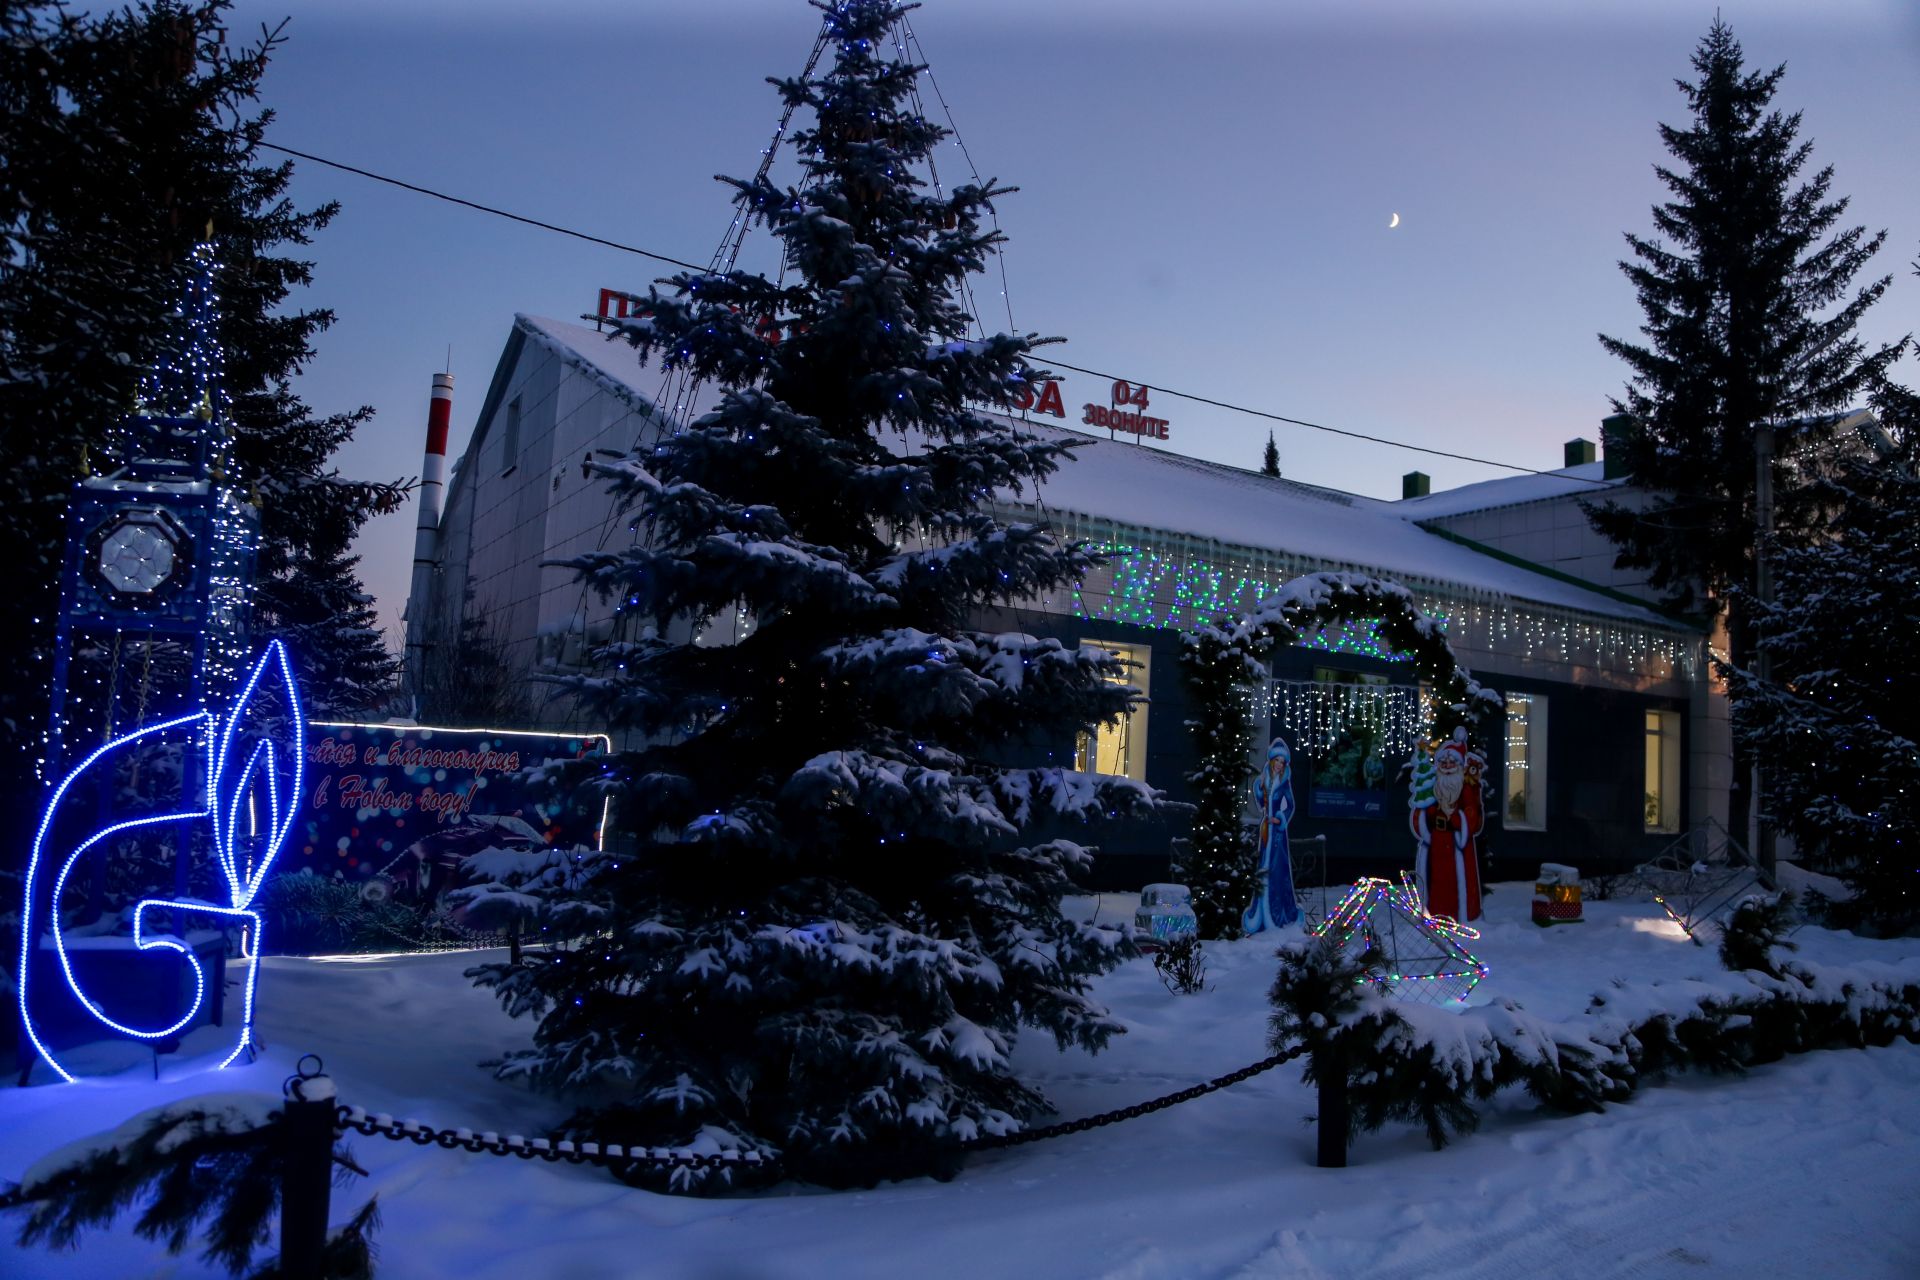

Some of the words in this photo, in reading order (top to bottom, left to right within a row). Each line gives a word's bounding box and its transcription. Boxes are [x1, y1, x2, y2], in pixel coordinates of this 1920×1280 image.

[1112, 380, 1149, 410] 04
[1082, 402, 1170, 441] ЗВОНИТЕ
[363, 745, 380, 766] и
[386, 738, 520, 780] благополучия
[312, 774, 332, 810] в
[338, 774, 414, 812] Новом
[420, 783, 479, 824] году!
